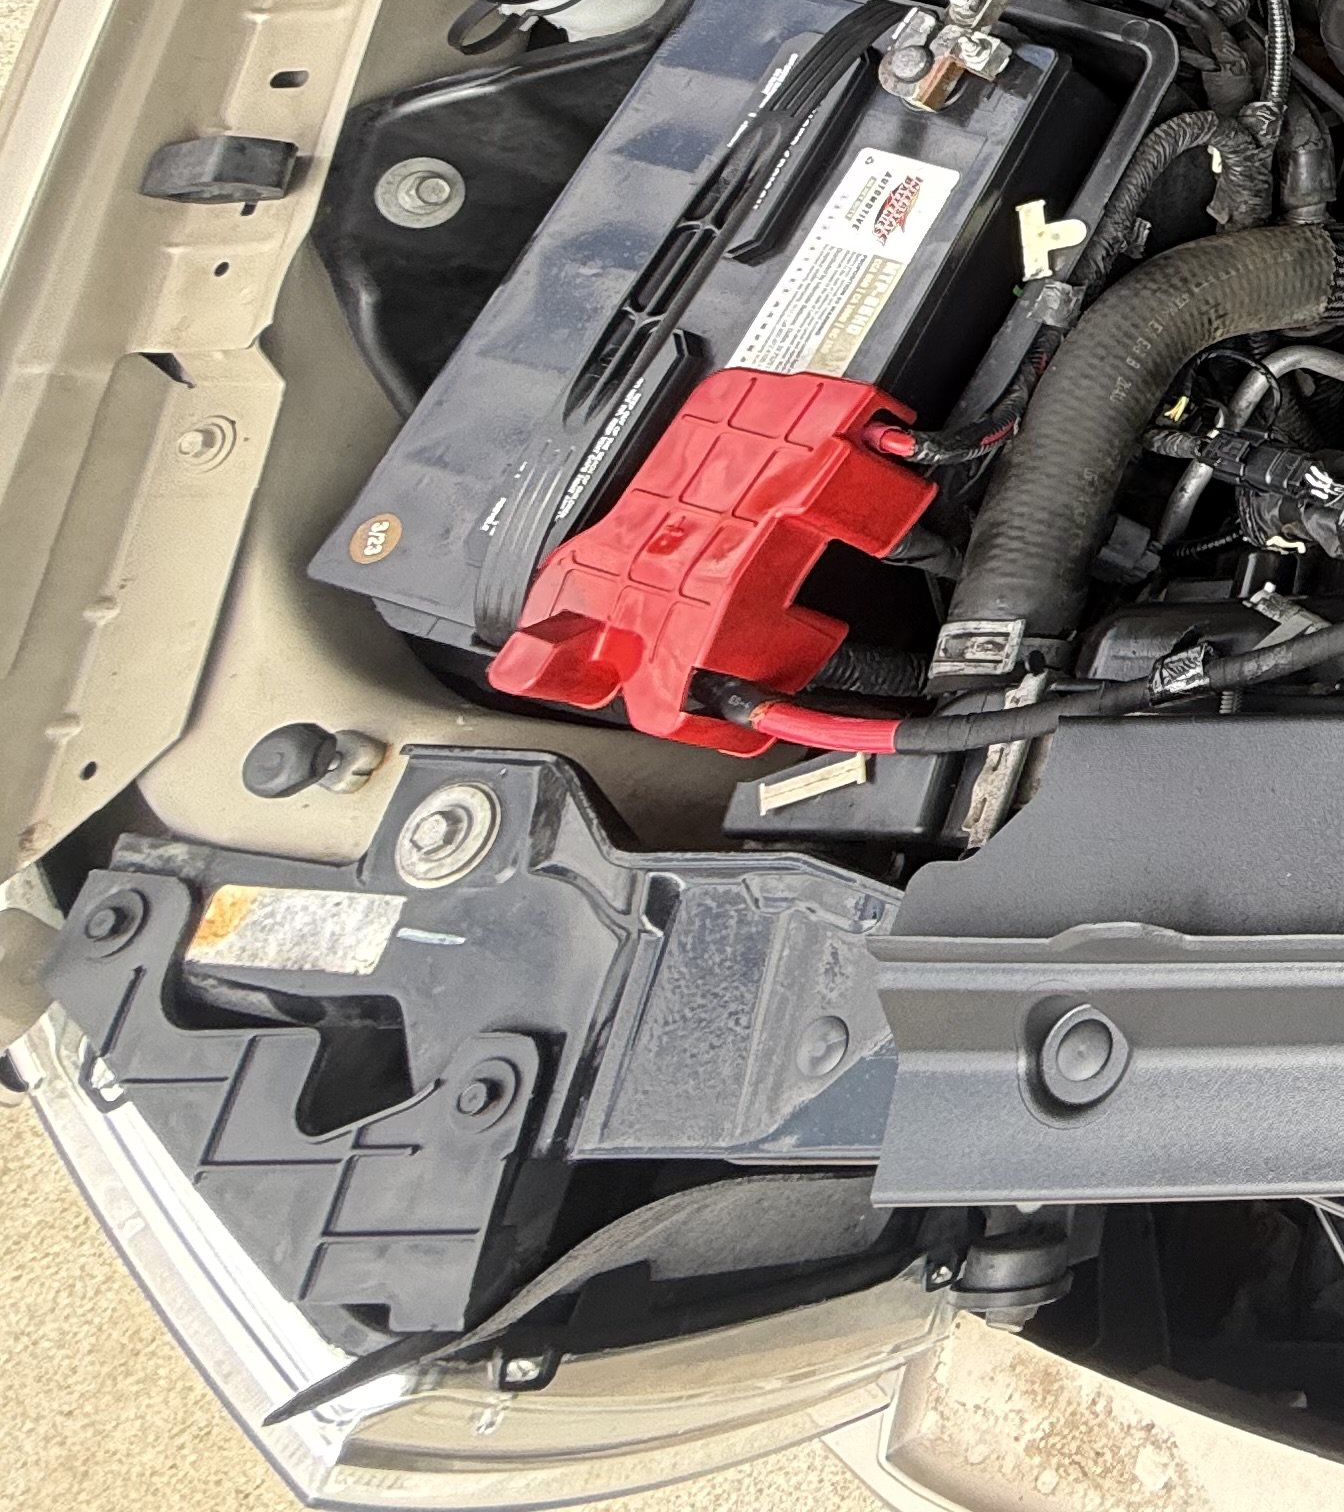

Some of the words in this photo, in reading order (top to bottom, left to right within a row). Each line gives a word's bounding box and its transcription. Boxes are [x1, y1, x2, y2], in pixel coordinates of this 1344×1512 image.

[851, 170, 893, 231] AUTOMOTIVE
[872, 174, 914, 237] BATTERIES
[875, 175, 924, 247] INTERSTATE
[362, 521, 390, 554] 3/23
